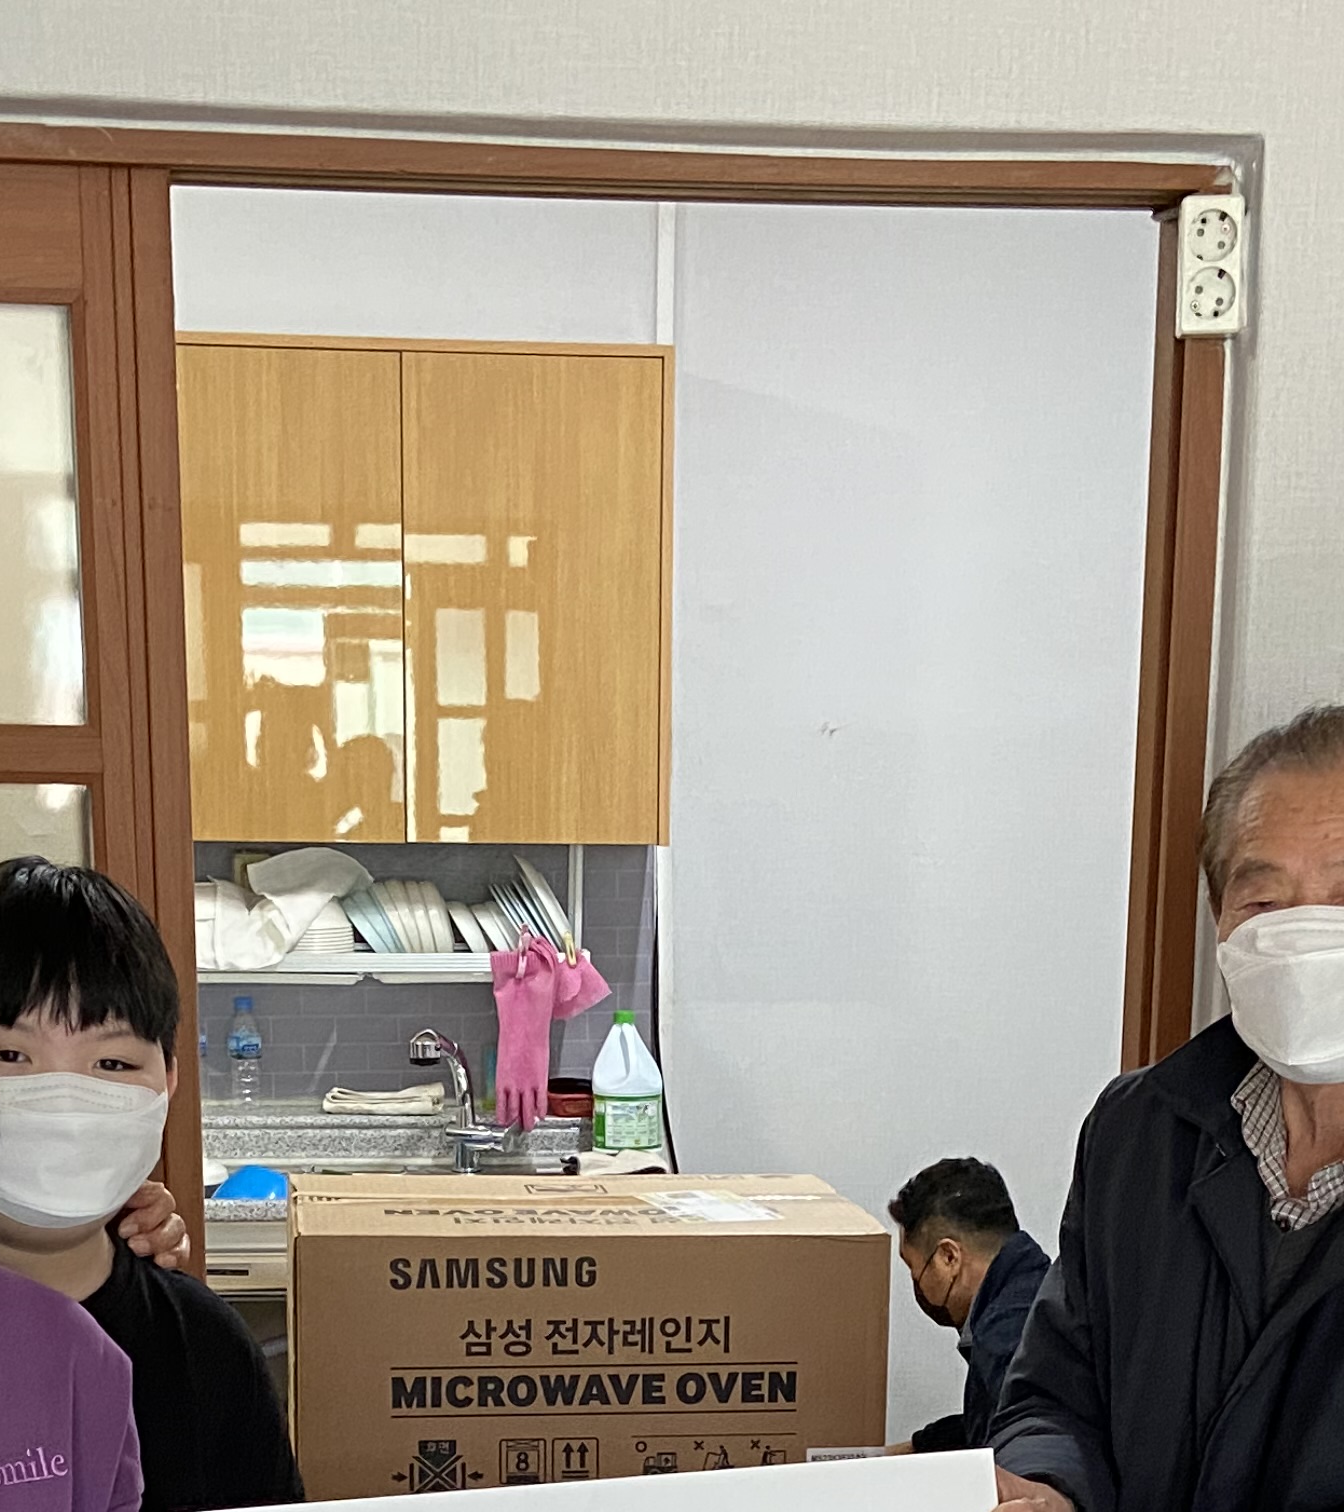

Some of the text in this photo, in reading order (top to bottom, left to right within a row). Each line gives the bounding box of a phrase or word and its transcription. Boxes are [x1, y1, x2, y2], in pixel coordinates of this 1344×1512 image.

[389, 1256, 598, 1290] SAMSUNG
[458, 1316, 732, 1357] 삼성 전자레인지
[391, 1371, 797, 1410] MICROWAVE OVEN
